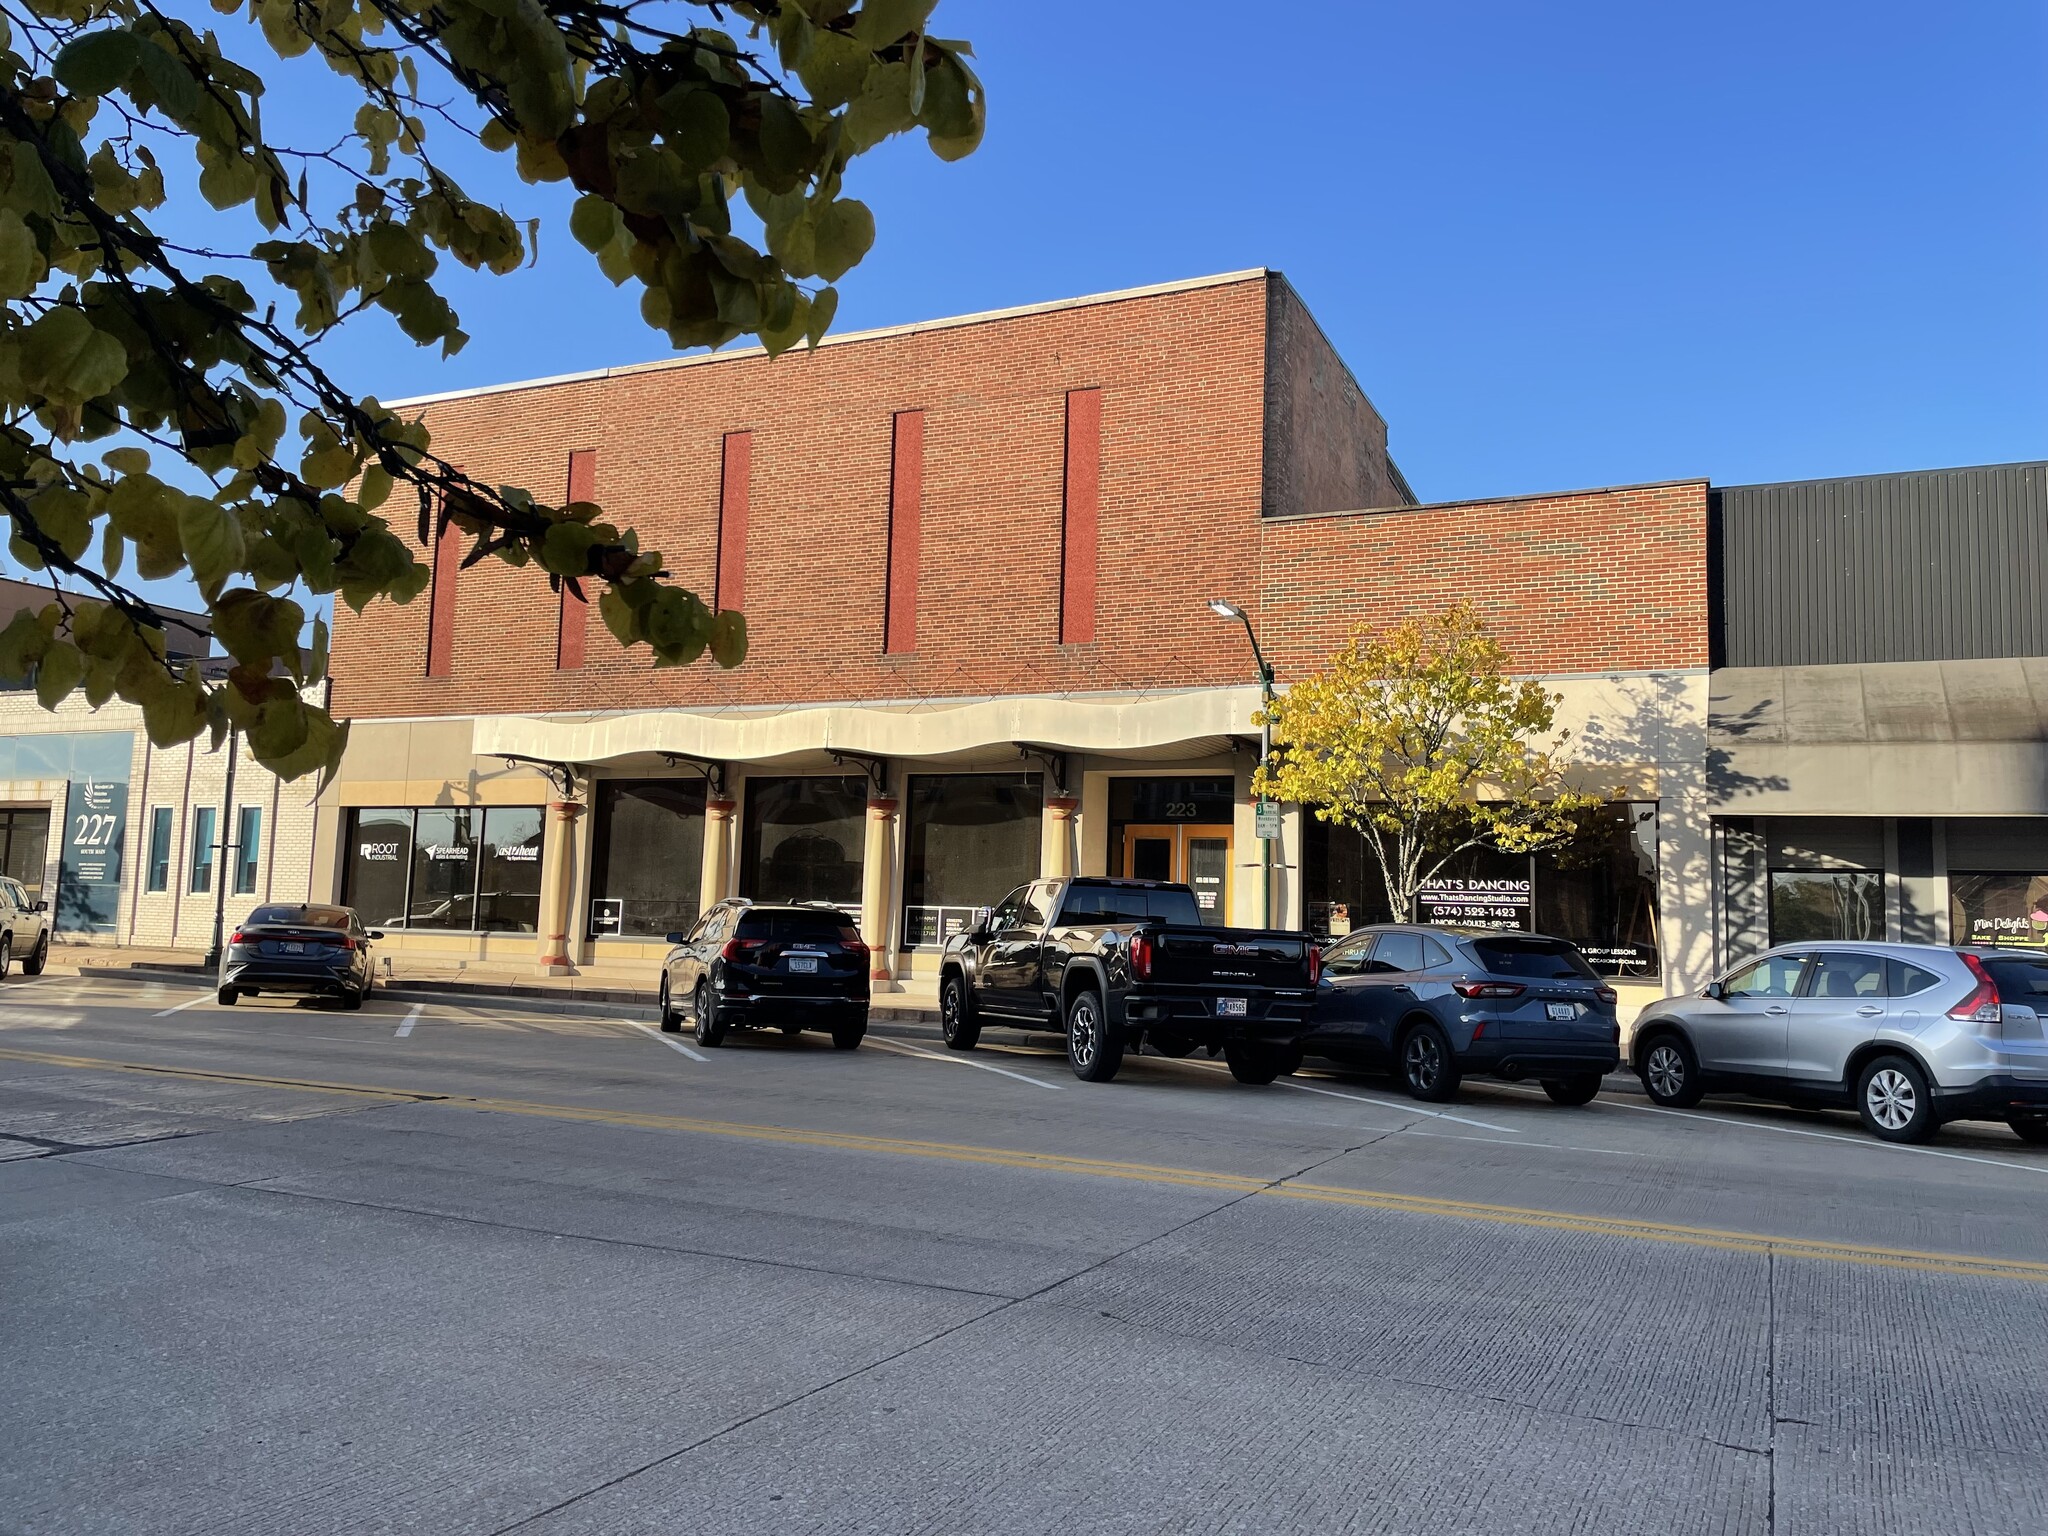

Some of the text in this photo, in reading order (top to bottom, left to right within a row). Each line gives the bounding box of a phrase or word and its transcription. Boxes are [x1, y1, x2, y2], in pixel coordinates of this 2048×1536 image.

[1166, 802, 1197, 817] 223
[73, 813, 117, 845] 227
[371, 843, 398, 854] ROOT
[435, 847, 468, 855] SPEARHEAD
[1469, 880, 1530, 891] DANCING
[1421, 894, 1528, 903] www.ThatsDancingStudio.com
[1433, 905, 1516, 917] (574) 522-1423
[1974, 916, 2030, 934] Mini Delights
[1213, 943, 1259, 956] GMC
[1610, 948, 1637, 956] LESSONS
